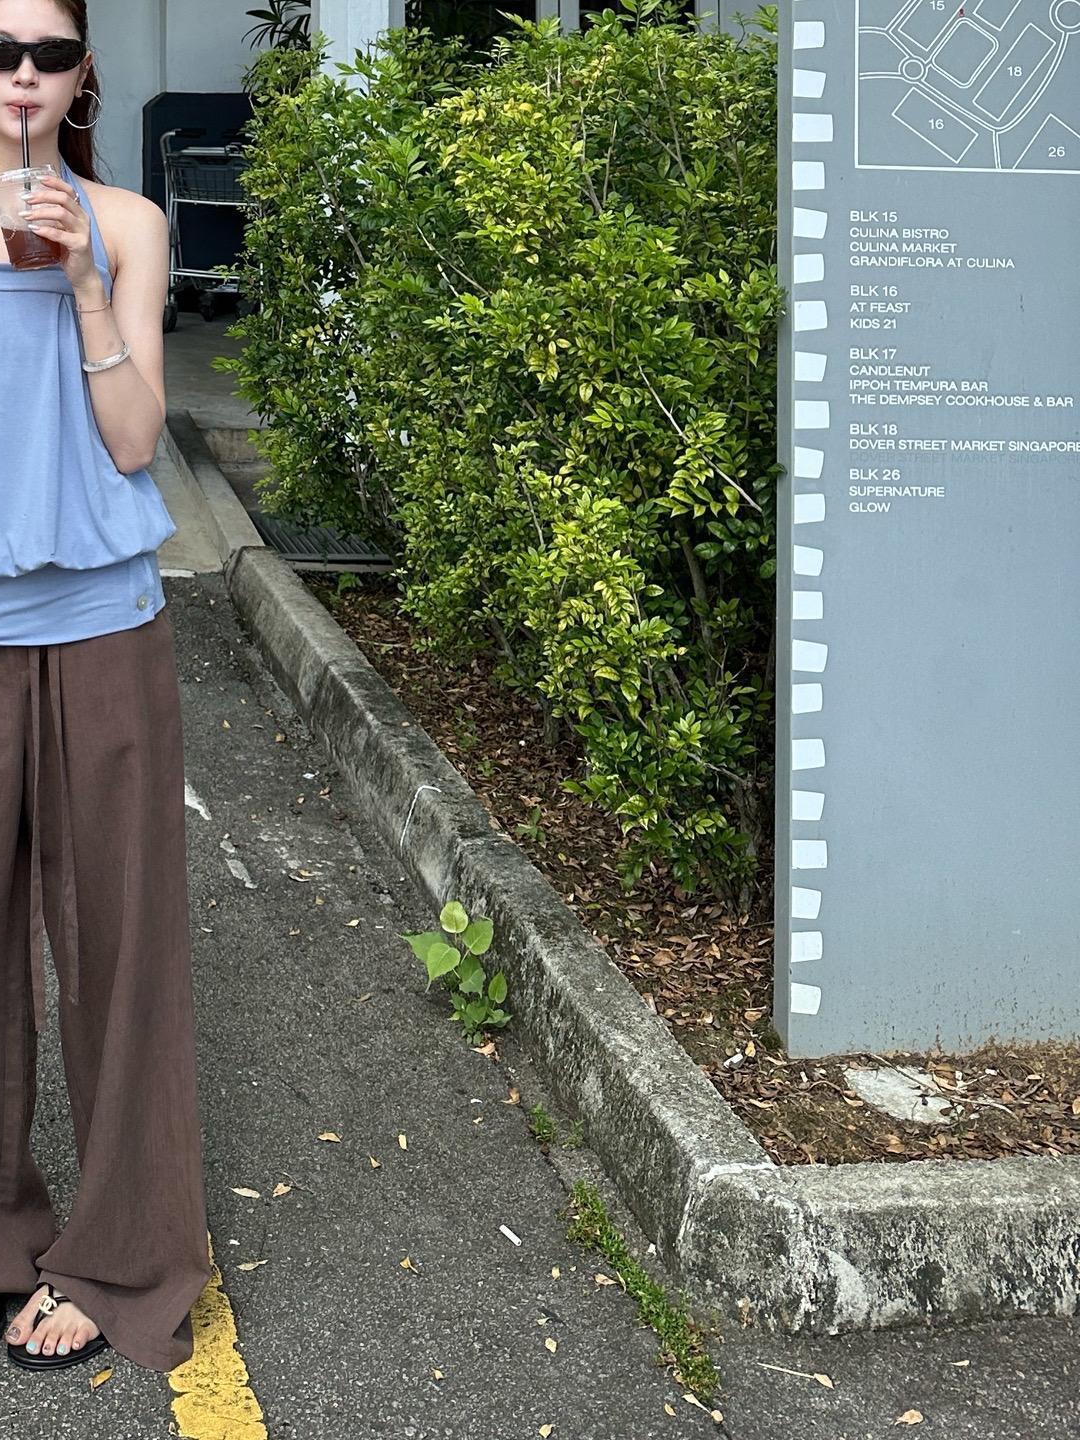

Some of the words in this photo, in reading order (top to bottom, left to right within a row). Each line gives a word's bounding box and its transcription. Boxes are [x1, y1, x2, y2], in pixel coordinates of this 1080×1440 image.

[931, 1, 944, 10] 15
[1008, 67, 1022, 76] 18
[929, 119, 943, 129] 16
[1049, 147, 1065, 157] 26
[849, 211, 879, 222] BLK
[883, 212, 898, 222] 15
[849, 228, 899, 238] CULINA
[903, 229, 950, 239] BISTRO
[849, 242, 900, 252] CULINA
[903, 243, 958, 253] MARKET
[849, 256, 944, 267] GRANDIFLORA
[947, 258, 964, 267] AT
[967, 258, 1015, 268] CULINA
[850, 285, 879, 296] BLK
[883, 286, 898, 296] 16
[849, 303, 867, 312] AT
[870, 303, 912, 313] FEAST
[850, 319, 881, 328] KIDS
[884, 319, 897, 329] 21
[849, 348, 879, 359] BLK
[883, 349, 897, 359] 17
[849, 365, 931, 376] CANDLENUT
[849, 380, 891, 390] IPPOH
[894, 380, 958, 391] TEMPURA
[961, 382, 988, 391] BAR
[848, 394, 876, 404] THE
[880, 395, 942, 405] DEMPSEY
[946, 395, 1030, 406] COOKHOUSE
[1034, 397, 1043, 406] &
[1047, 397, 1074, 407] BAR
[849, 424, 879, 435] BLK
[883, 424, 898, 435] 18
[849, 439, 896, 449] DOVER
[899, 440, 948, 450] STREET
[951, 441, 1006, 451] MARKET
[1009, 441, 1080, 452] SINGAPORE
[849, 469, 879, 480] BLK
[883, 469, 901, 480] 26
[848, 486, 945, 497] SUPERNATURE
[849, 502, 891, 512] GLOW
